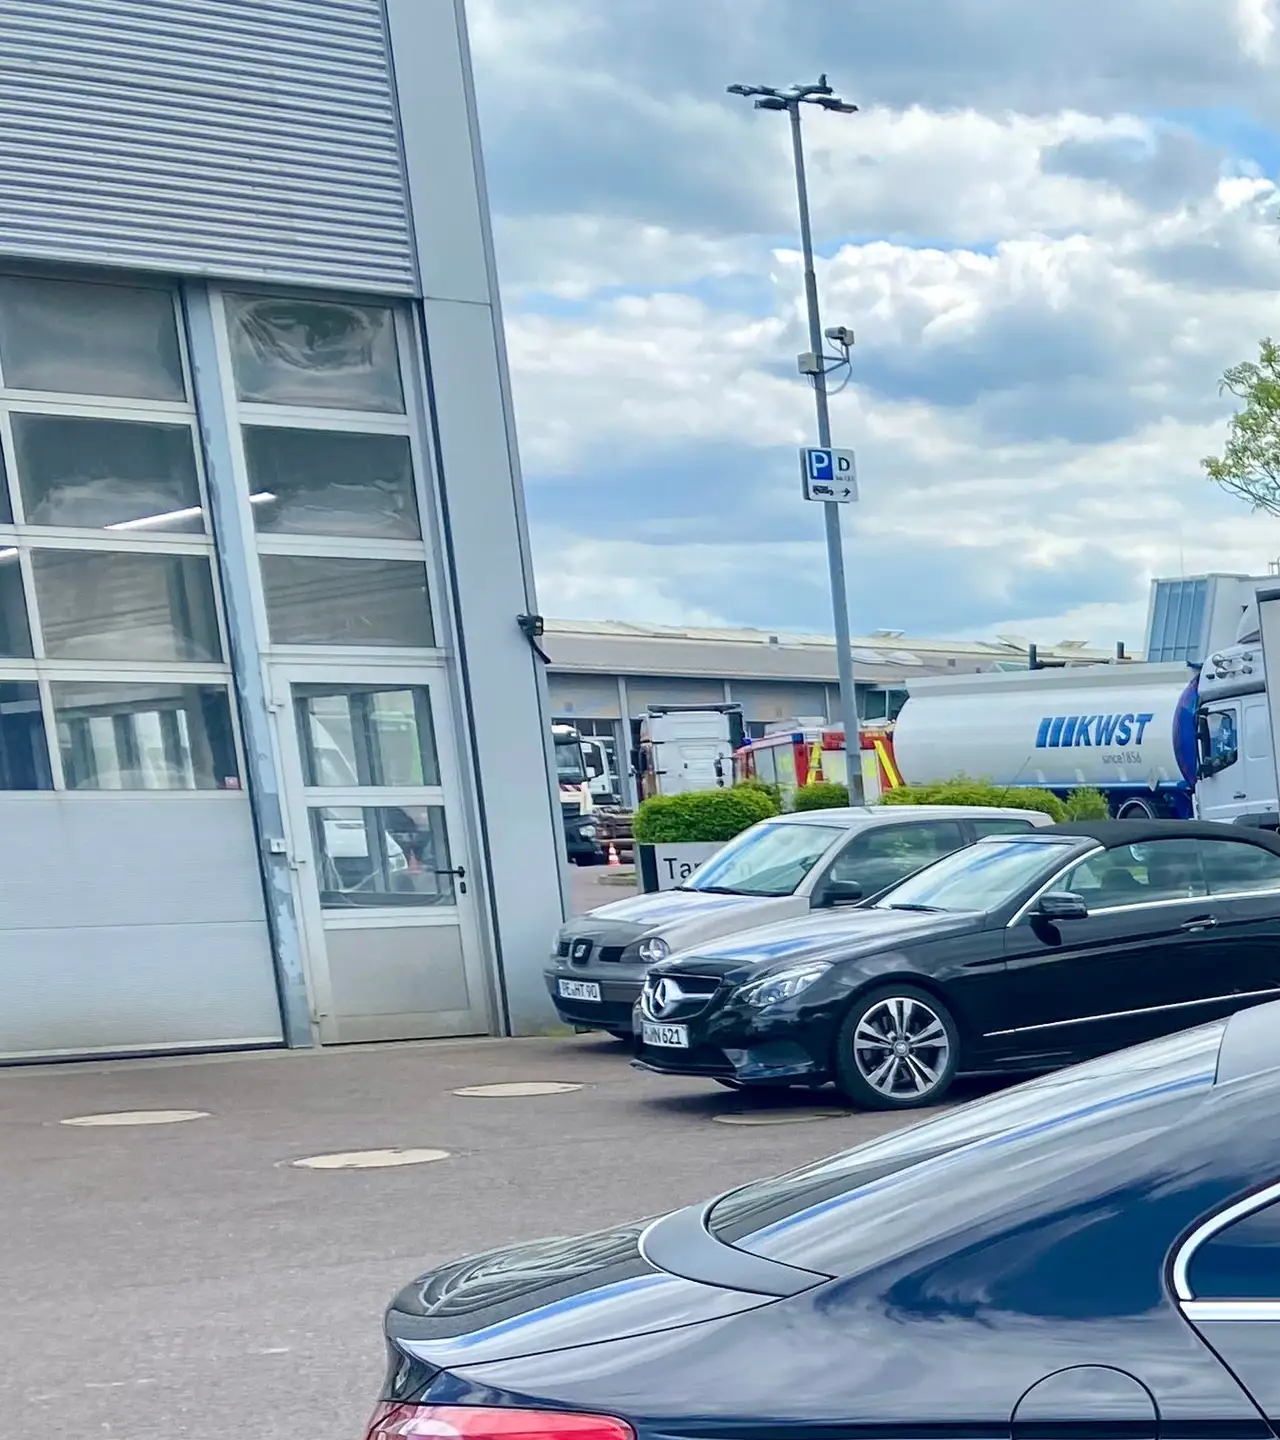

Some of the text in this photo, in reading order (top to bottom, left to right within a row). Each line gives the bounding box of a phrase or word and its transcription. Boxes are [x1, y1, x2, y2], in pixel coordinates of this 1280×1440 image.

[811, 451, 850, 477] P D
[1074, 713, 1155, 747] KWST
[662, 1028, 682, 1044] 621
